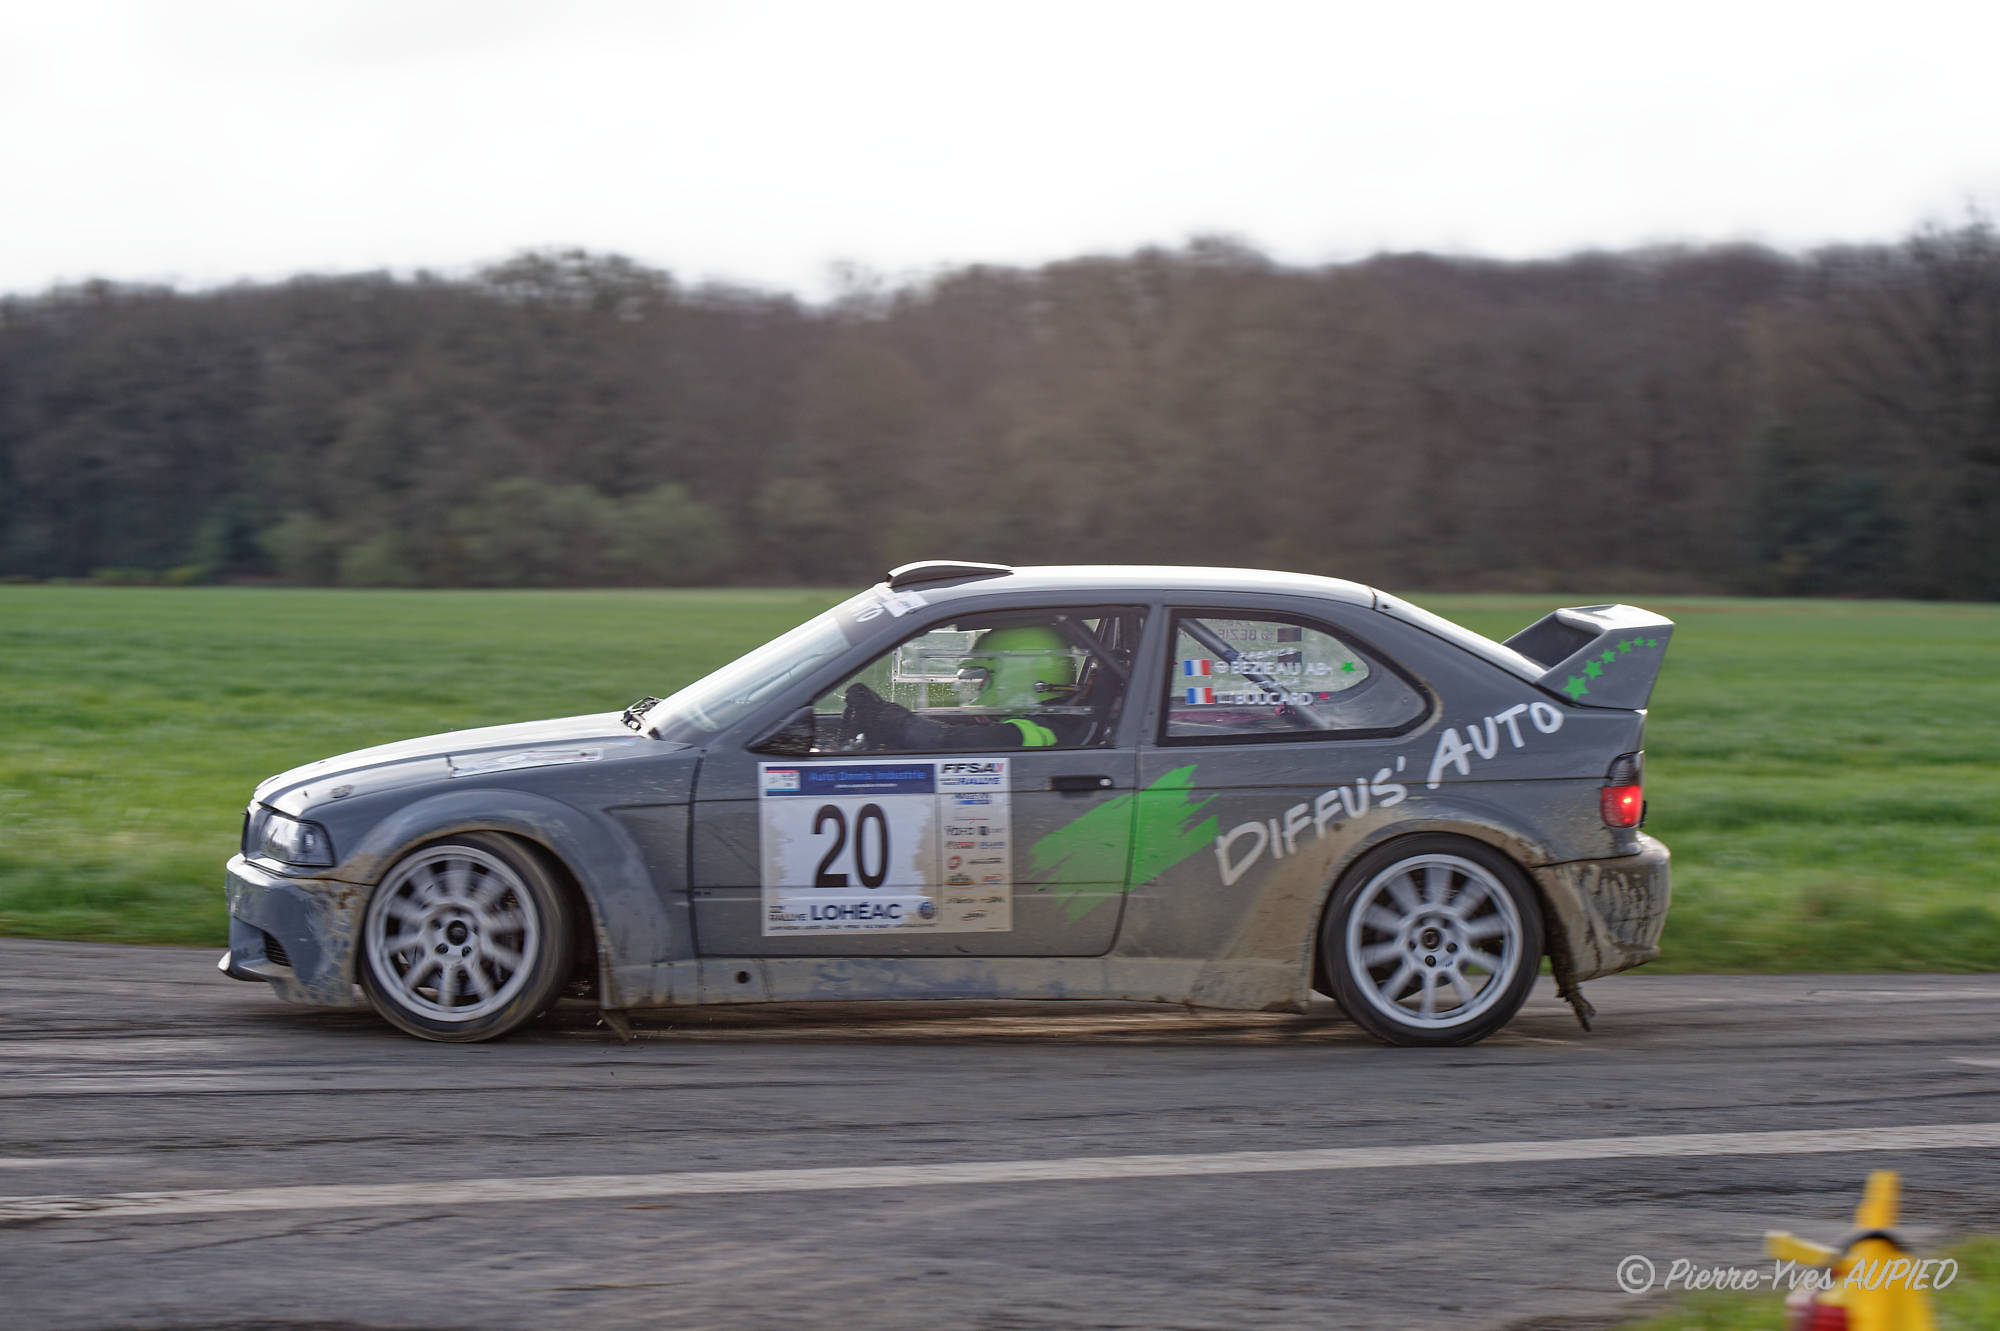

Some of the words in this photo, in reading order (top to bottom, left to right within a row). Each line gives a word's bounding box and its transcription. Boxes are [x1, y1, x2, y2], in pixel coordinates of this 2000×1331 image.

[1234, 692, 1314, 706] BOUCARD
[942, 763, 993, 774] FFSA
[1214, 756, 1408, 886] DIFFUS'
[1427, 702, 1564, 789] AUTO
[812, 803, 890, 889] 20
[810, 902, 902, 920] LOHÉAC
